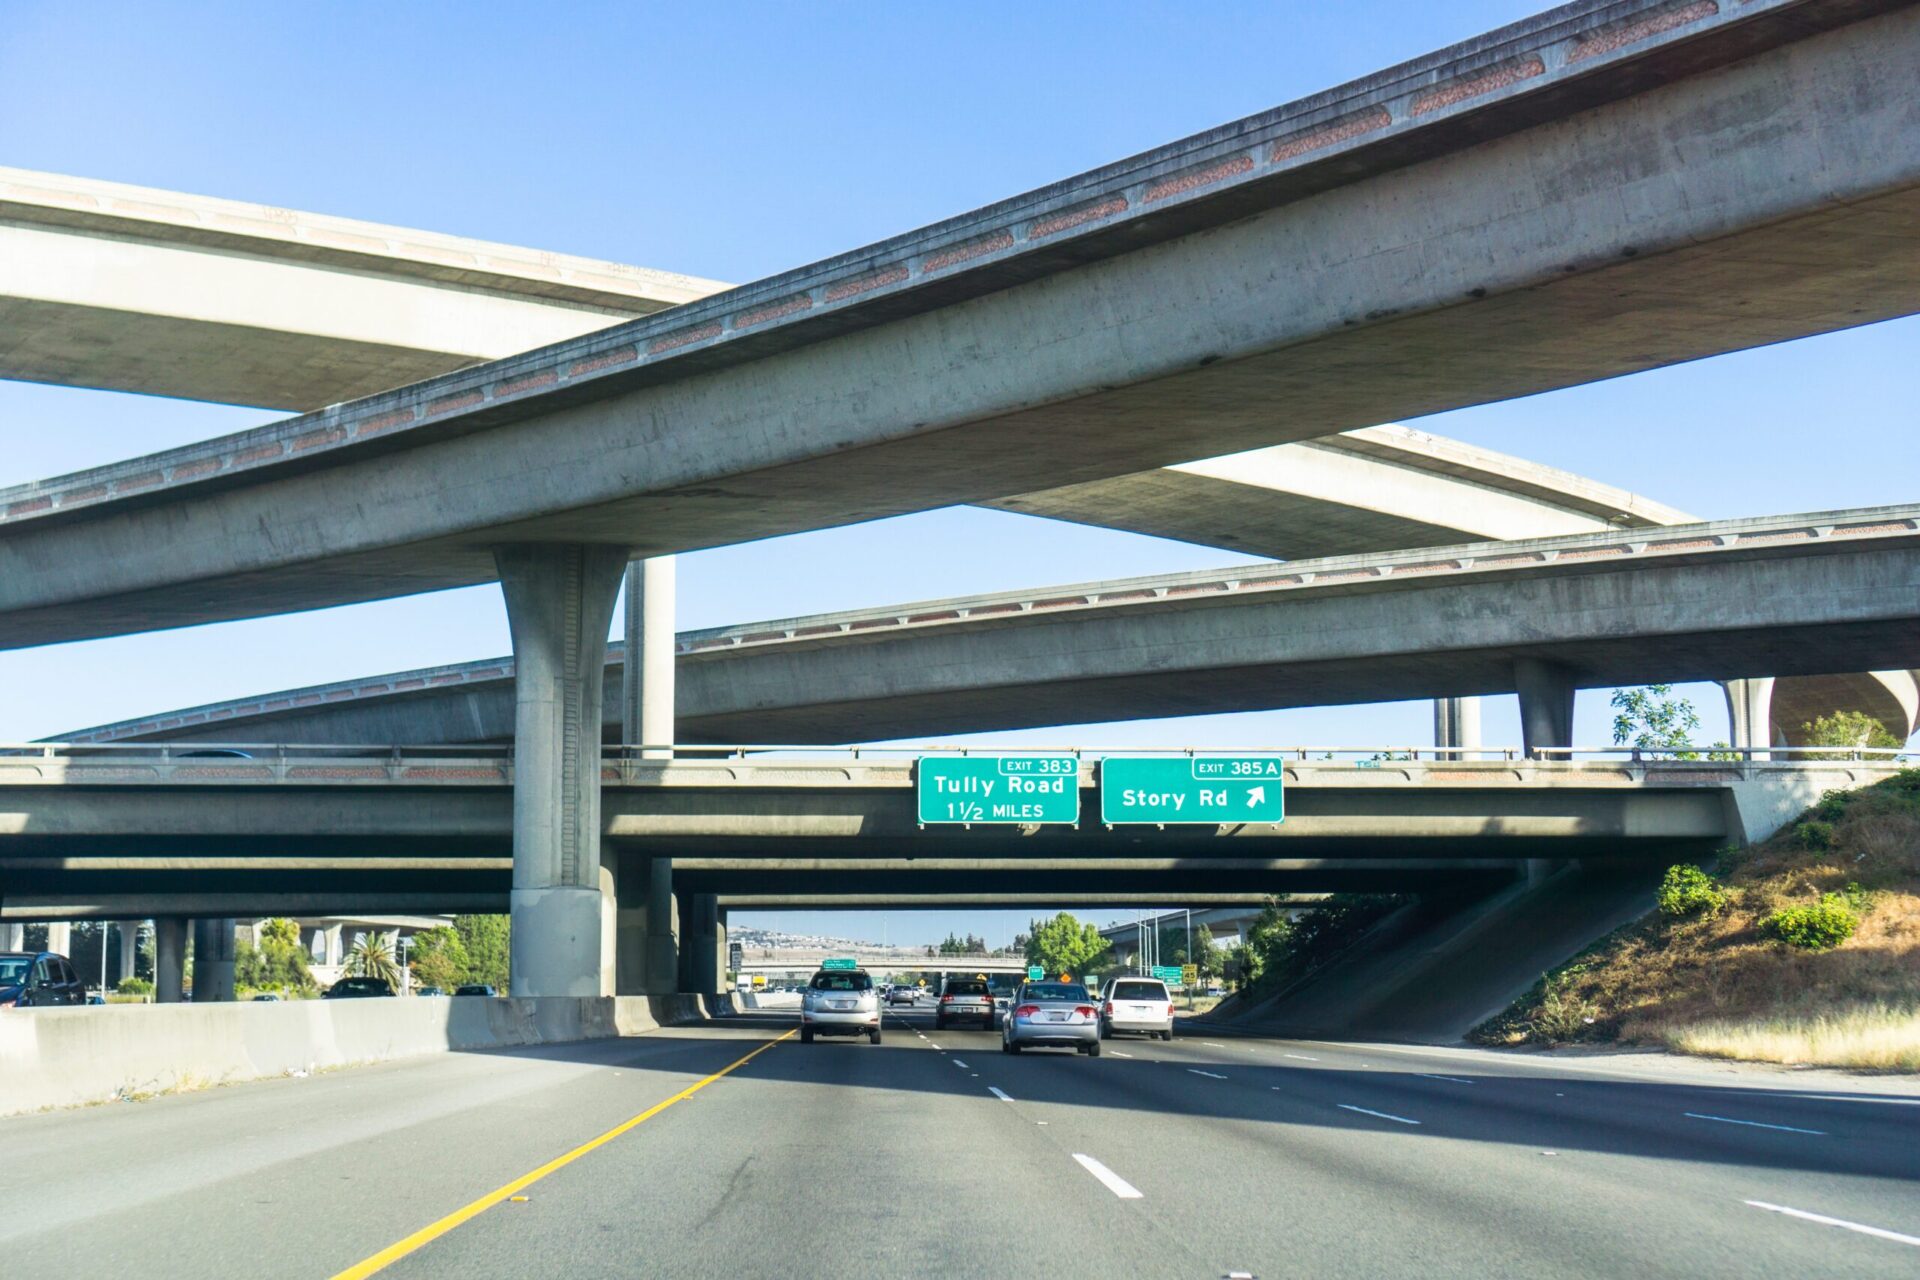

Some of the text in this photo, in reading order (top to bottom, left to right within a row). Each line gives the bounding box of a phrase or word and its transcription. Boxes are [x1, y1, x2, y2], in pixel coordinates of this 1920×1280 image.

[1007, 760, 1073, 773] EXIT 383
[1200, 763, 1224, 774] EXIT
[934, 775, 1065, 798] Tully Road
[1122, 789, 1229, 811] Story Rd
[993, 804, 1044, 819] MILES
